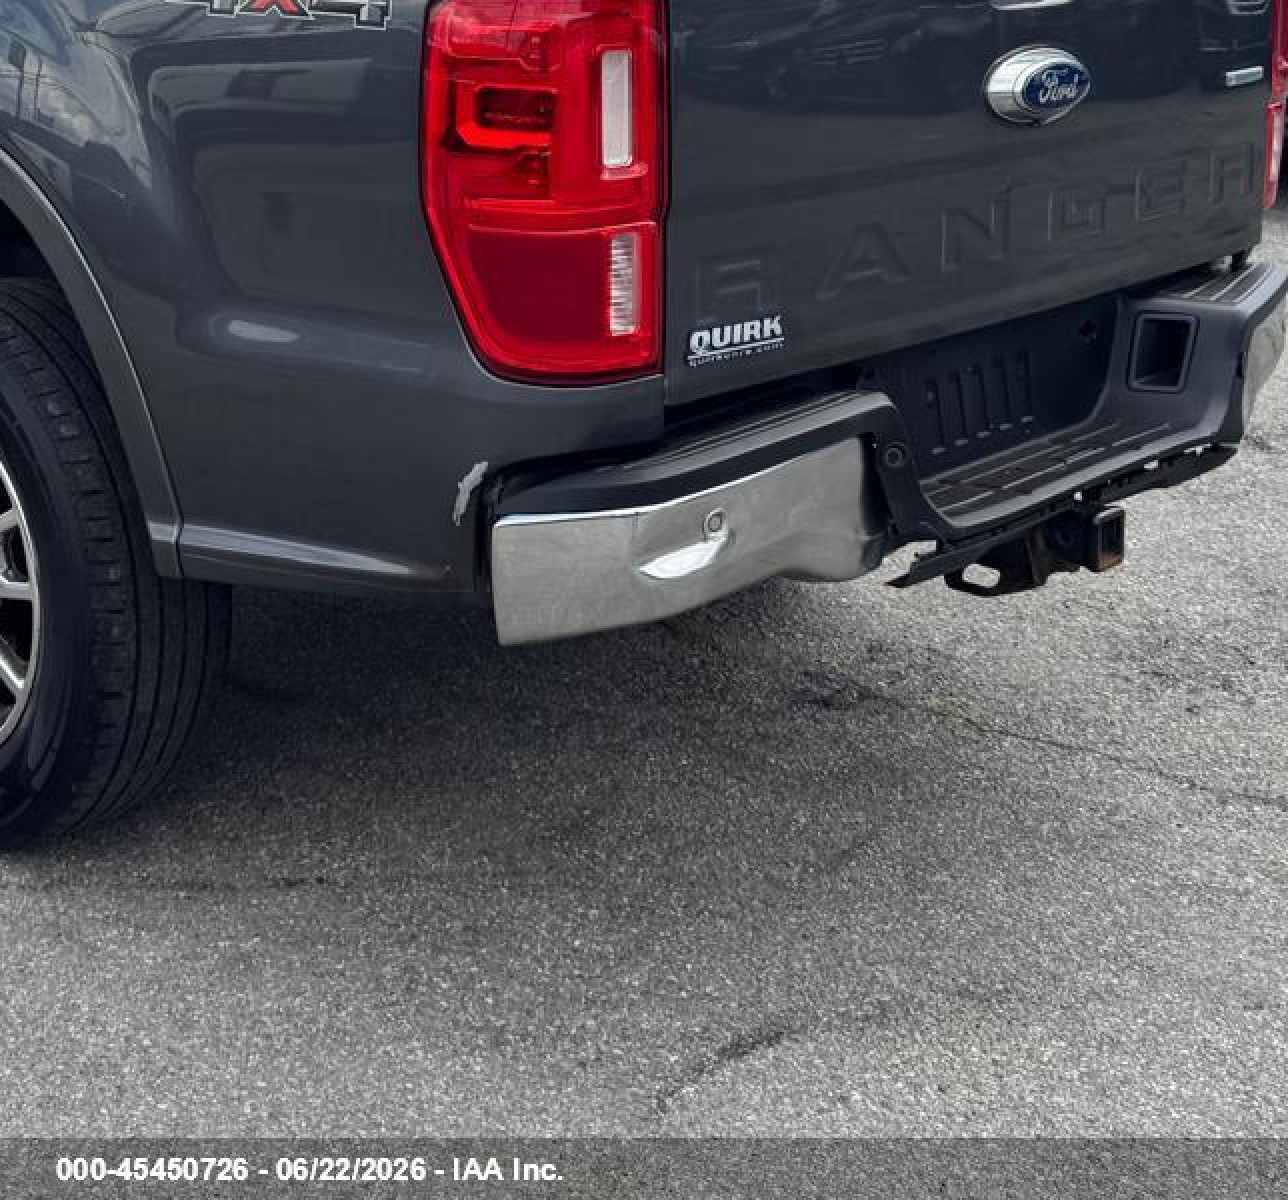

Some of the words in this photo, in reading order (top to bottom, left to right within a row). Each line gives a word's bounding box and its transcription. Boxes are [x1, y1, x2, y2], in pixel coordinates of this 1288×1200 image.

[1037, 68, 1080, 103] Ford
[697, 143, 1253, 322] RANGER
[689, 315, 783, 356] QUIRK
